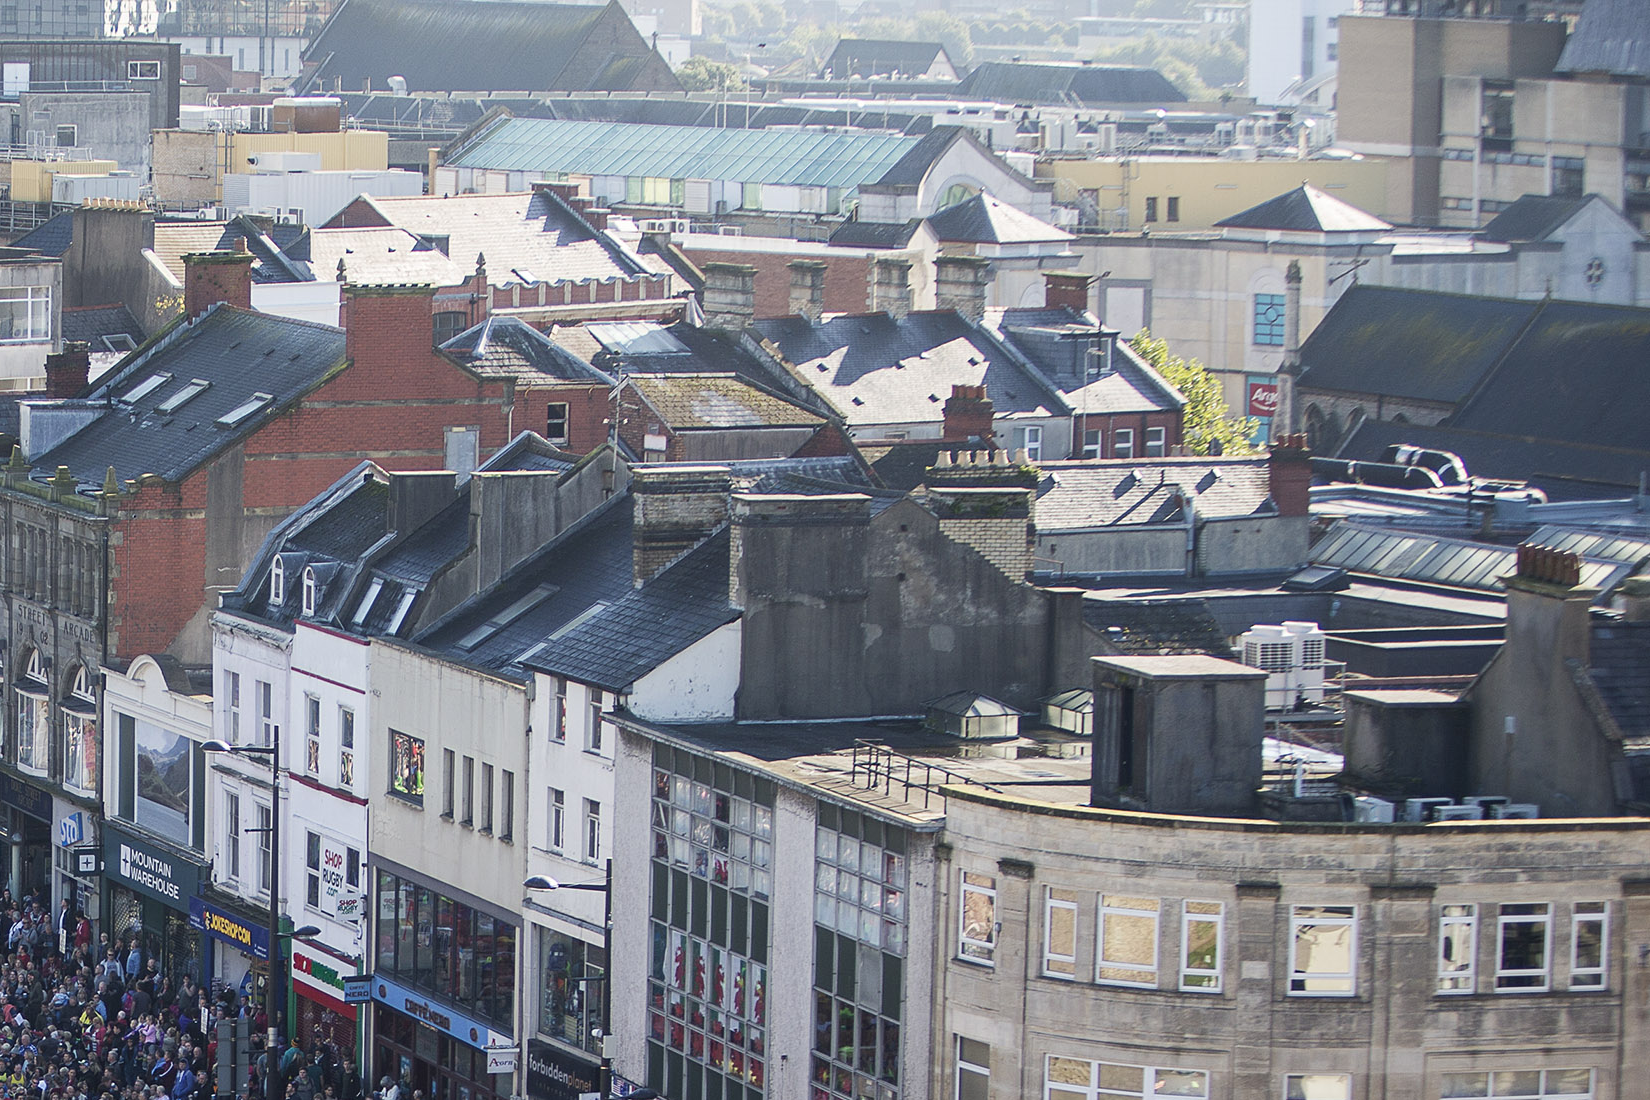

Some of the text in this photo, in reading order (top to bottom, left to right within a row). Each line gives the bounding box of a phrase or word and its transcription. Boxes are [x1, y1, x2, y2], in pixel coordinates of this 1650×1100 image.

[1251, 387, 1278, 405] Arg
[18, 604, 46, 626] STREET
[63, 621, 95, 643] ARCADE
[131, 849, 171, 878] MOUNTAIN
[325, 849, 342, 869] SHOP
[131, 866, 179, 900] WAREHOUSE
[323, 868, 343, 888] RUGBY
[489, 1058, 513, 1067] Acorn
